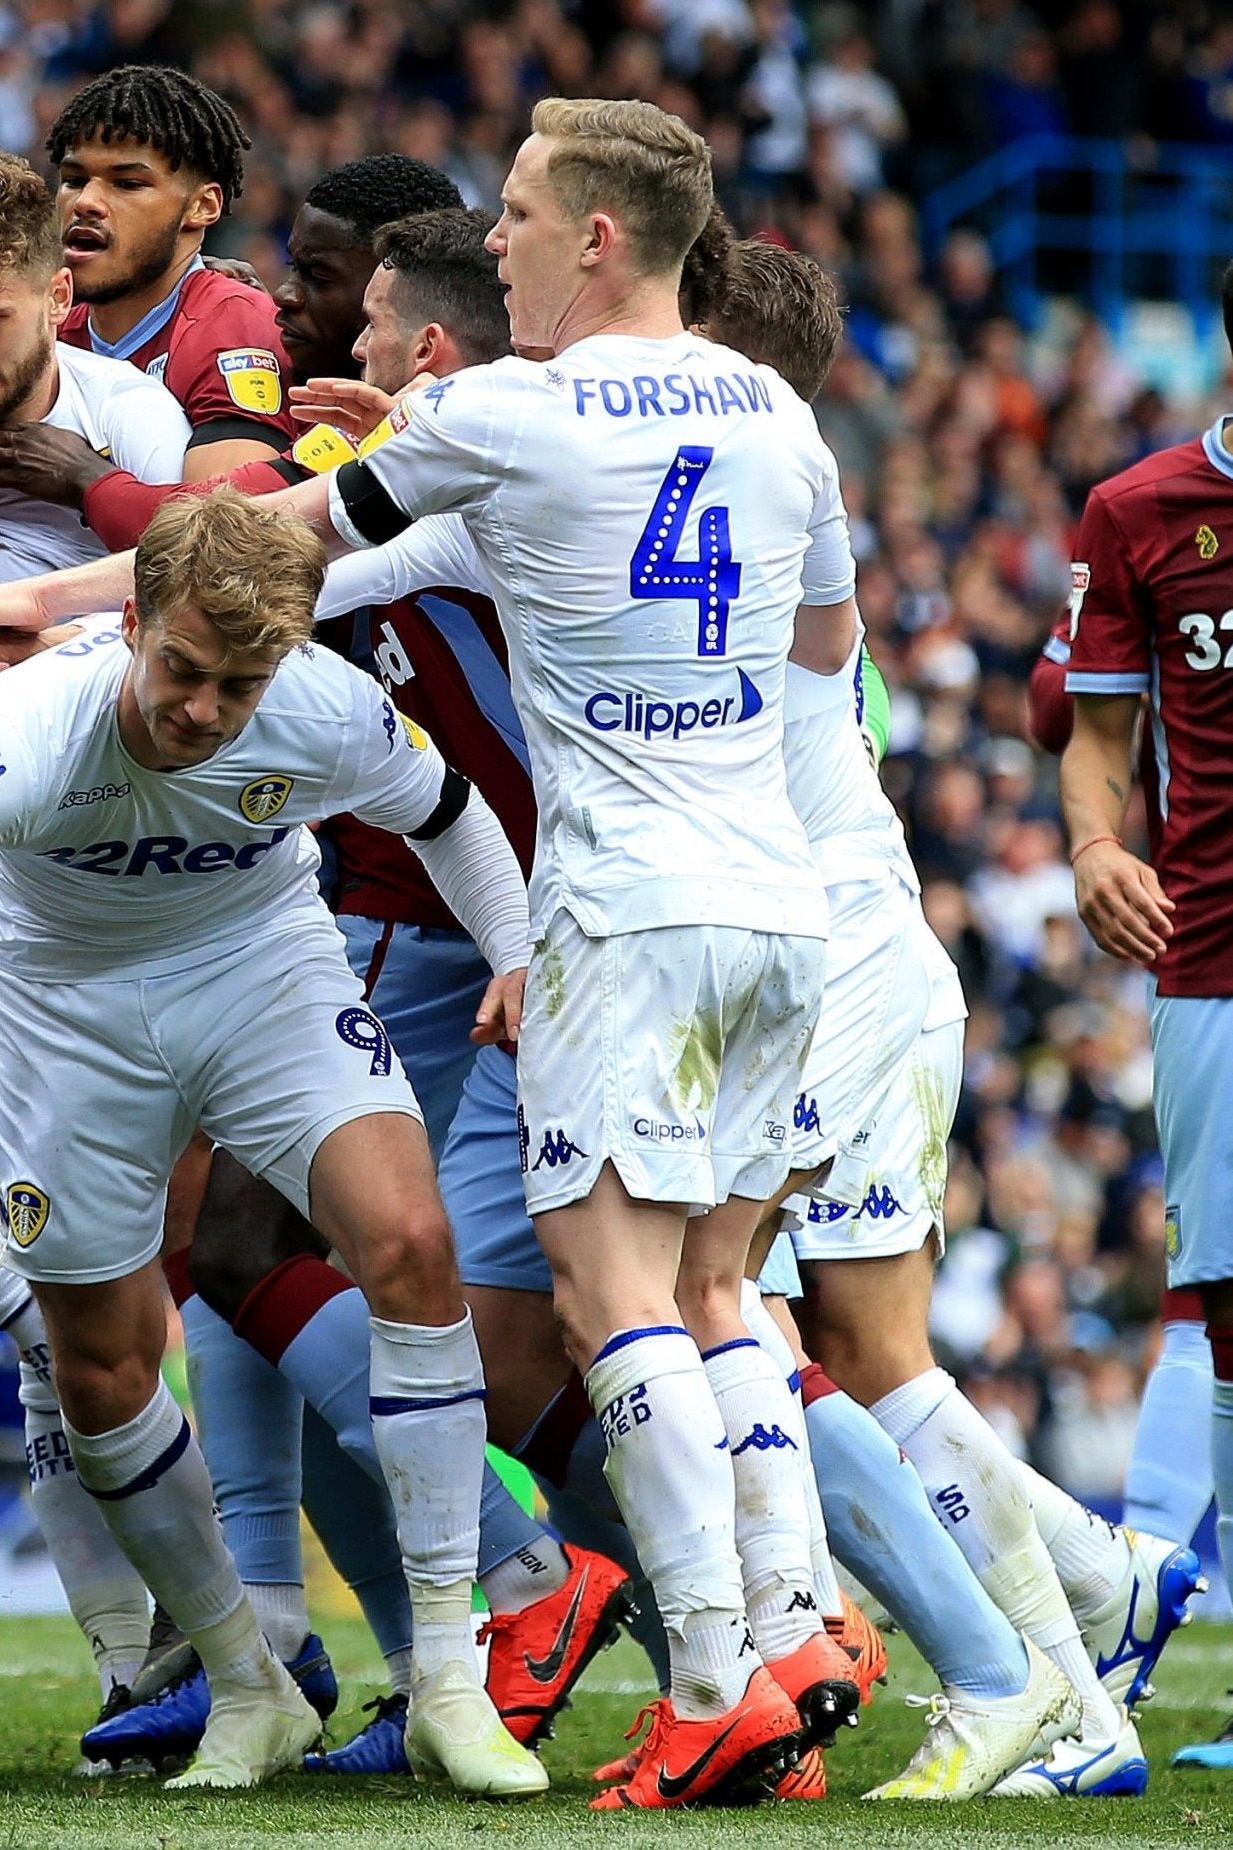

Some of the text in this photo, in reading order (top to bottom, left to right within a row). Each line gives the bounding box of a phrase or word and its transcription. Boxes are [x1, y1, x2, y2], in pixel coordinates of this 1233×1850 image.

[222, 355, 276, 371] sky bet
[573, 372, 774, 418] FORSHAW
[630, 445, 742, 656] 4
[584, 691, 735, 740] Clipper
[58, 783, 131, 810] Kappa
[336, 1007, 392, 1076] 9
[633, 1118, 699, 1142] Clipper
